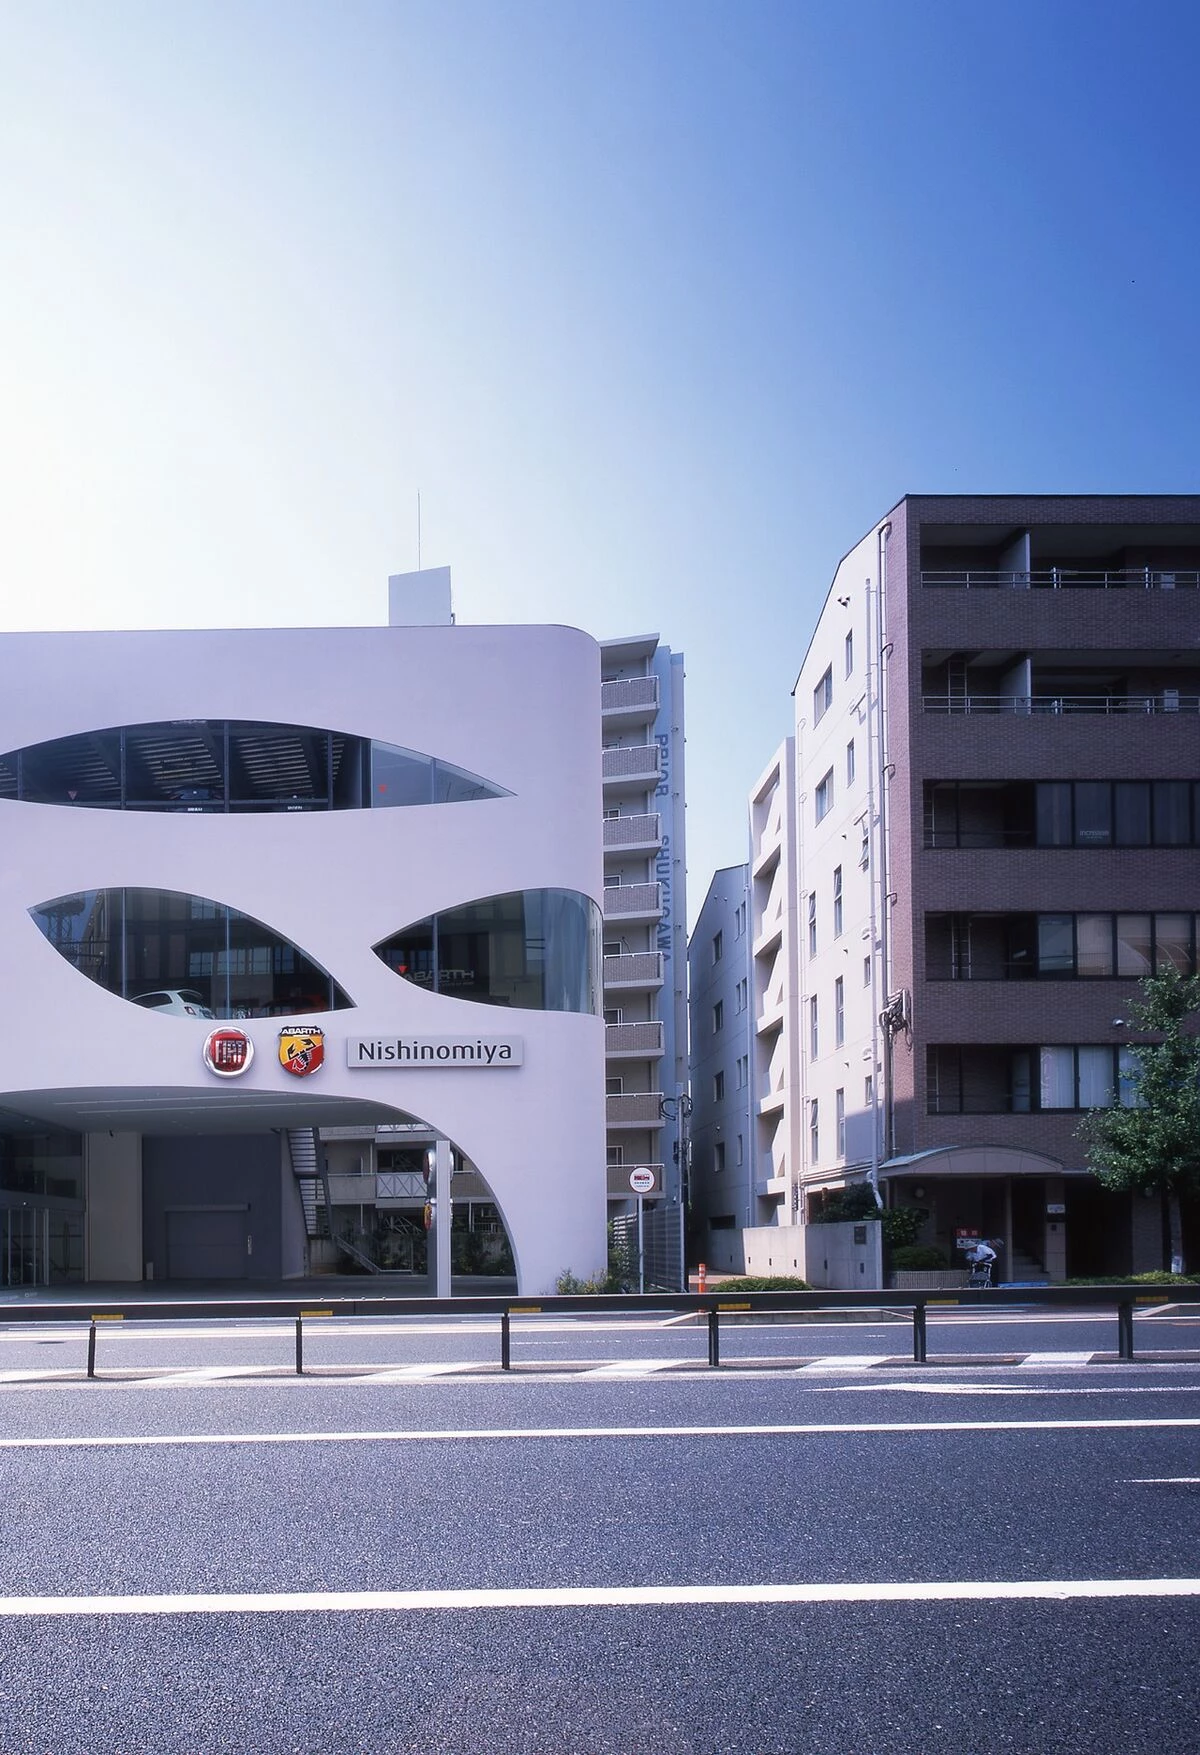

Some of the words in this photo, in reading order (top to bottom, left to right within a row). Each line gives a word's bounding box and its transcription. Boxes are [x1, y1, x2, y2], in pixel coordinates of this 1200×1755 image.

[281, 1027, 321, 1035] ABARTH
[215, 1040, 245, 1063] FIAT
[358, 1040, 512, 1064] Nishinomiya
